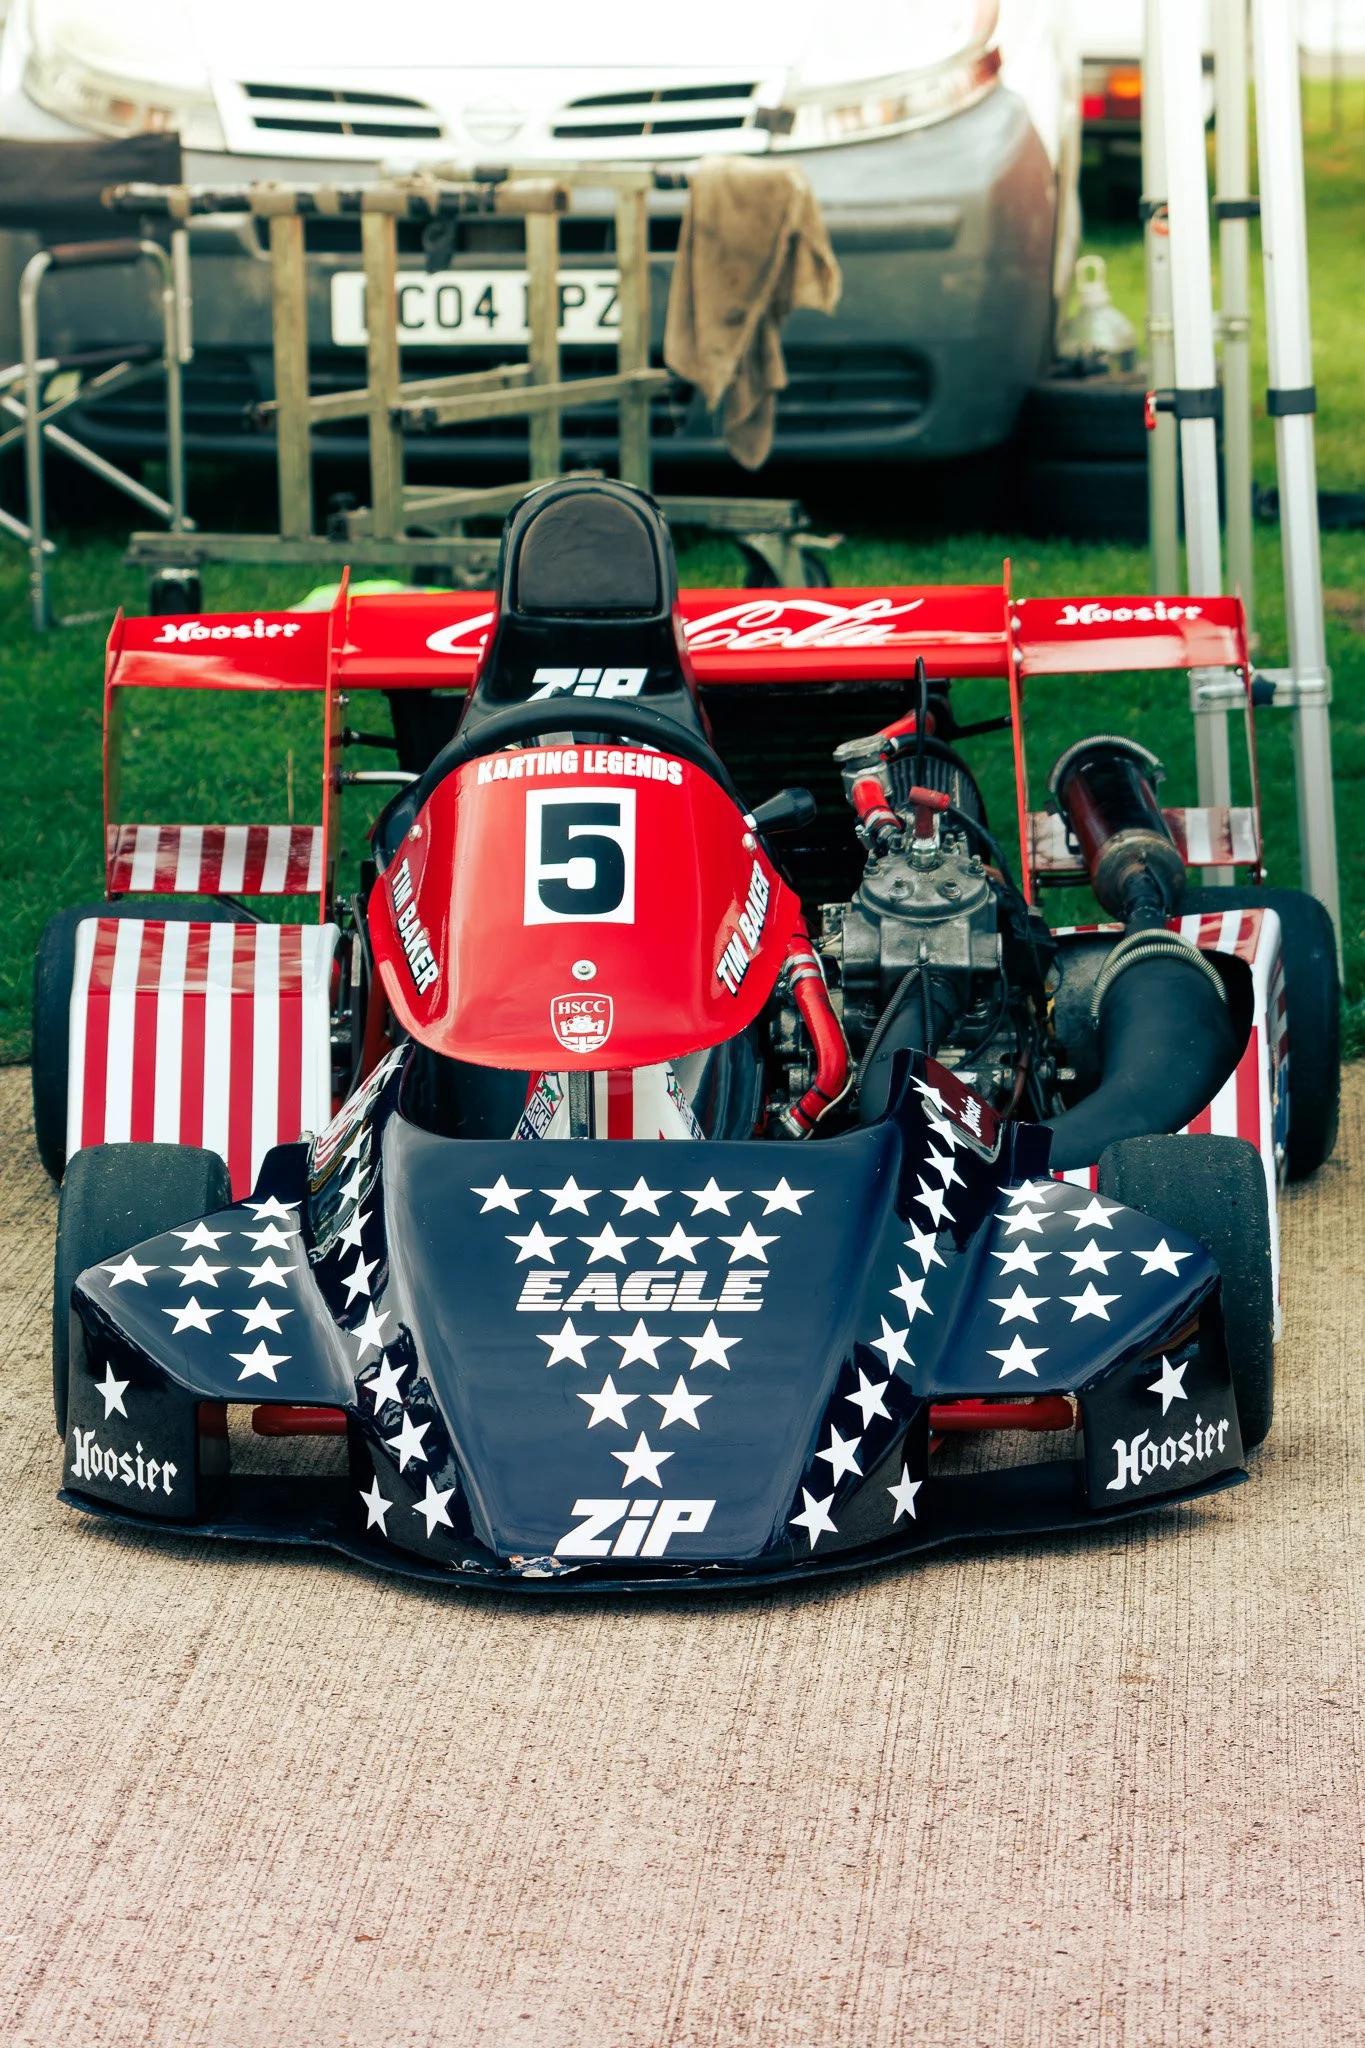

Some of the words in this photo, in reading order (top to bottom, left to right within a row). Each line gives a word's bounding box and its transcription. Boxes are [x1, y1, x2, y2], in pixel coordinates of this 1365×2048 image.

[362, 284, 499, 330] C04
[522, 284, 621, 328] PZ
[153, 617, 301, 643] Hoosier
[1055, 600, 1203, 626] Hoosier
[477, 750, 579, 786] KARTING
[583, 749, 684, 786] LEGENDS
[537, 802, 626, 916] 5
[391, 857, 413, 914] TIM
[396, 900, 440, 996] BAKER
[716, 931, 750, 998] TIM
[738, 859, 771, 955] BAKER
[557, 1000, 606, 1015] HSCC
[515, 1270, 771, 1312] EAGLE
[70, 1426, 178, 1496] Hoosier
[1105, 1413, 1230, 1491] Hoosier
